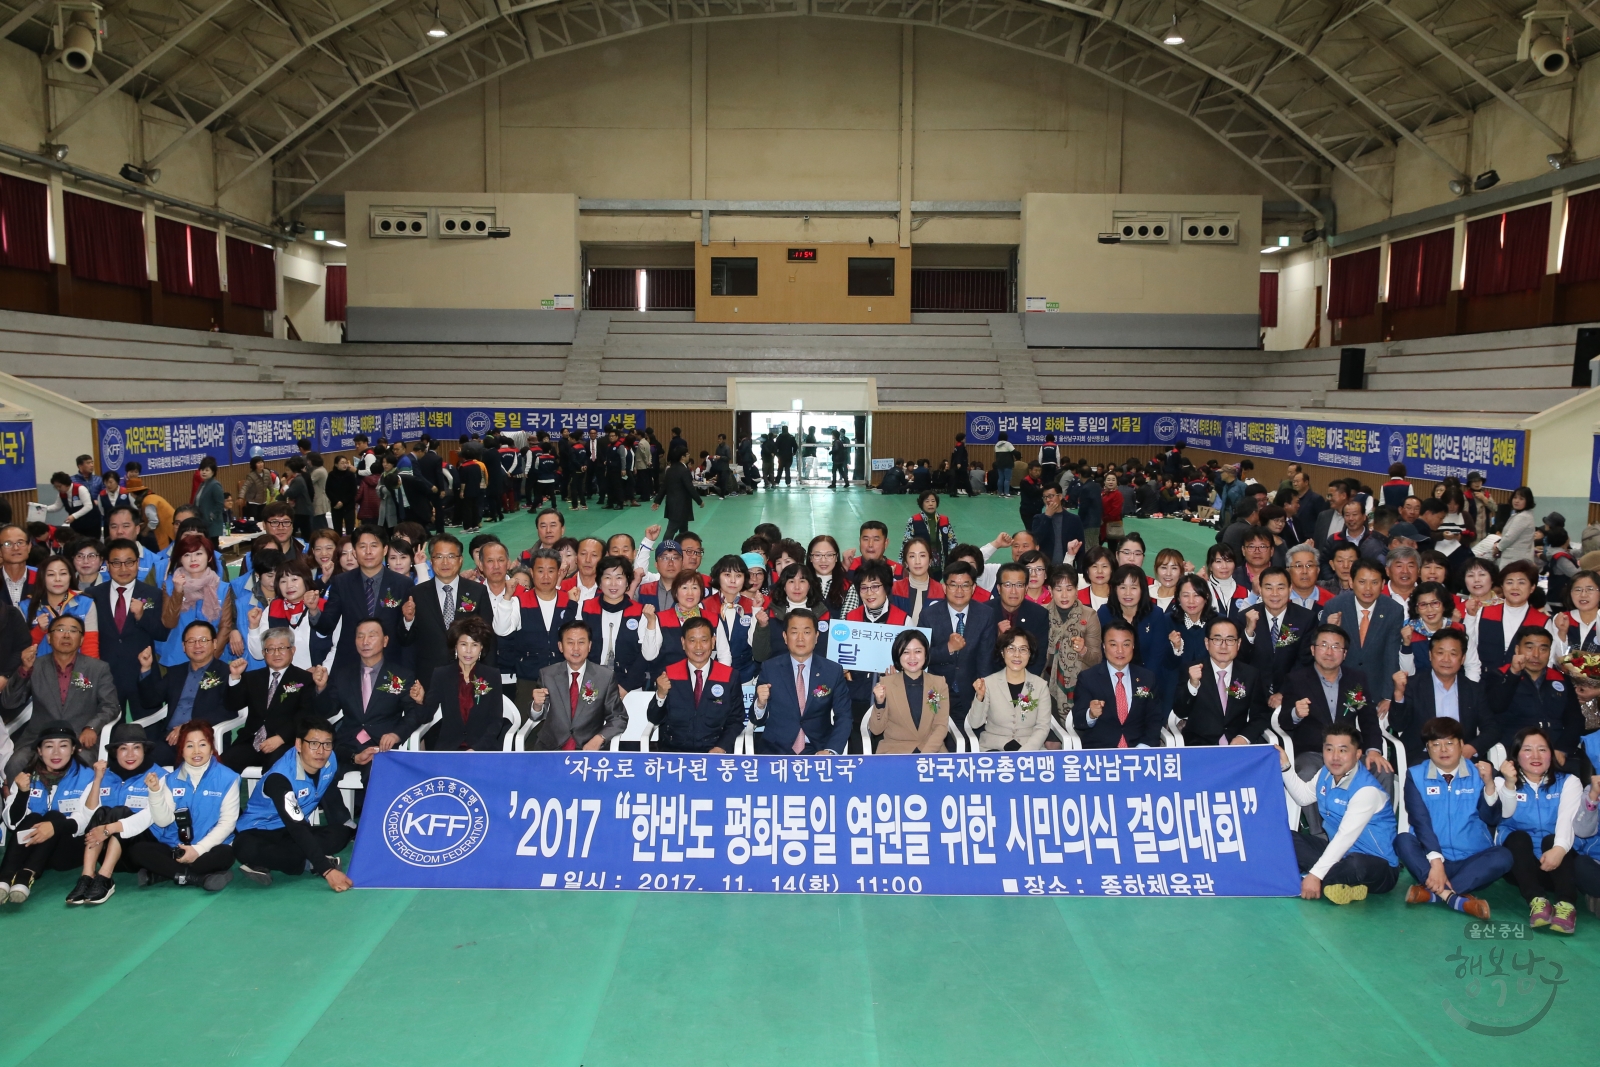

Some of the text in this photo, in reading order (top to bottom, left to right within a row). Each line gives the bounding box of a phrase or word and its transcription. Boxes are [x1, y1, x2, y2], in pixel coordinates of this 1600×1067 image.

[247, 420, 273, 444] 국민통합을
[273, 419, 292, 442] 주도하는
[306, 418, 316, 438] 조직
[428, 411, 452, 428] 선봉대
[493, 412, 637, 430] 통일 국가 건설의 선봉
[998, 416, 1142, 432] 남과 북의 화해는 통일의 지름길
[125, 425, 172, 454] 자유민주주의를
[172, 424, 196, 451] 수호하는
[1248, 422, 1264, 442] 대한민국
[1306, 426, 1326, 448] 회원역량
[1344, 429, 1367, 453] 국민운동
[1368, 430, 1380, 454] 선도
[106, 444, 120, 456] KFF
[1406, 432, 1516, 467] 젊은 인재 양성으로 연맹회원 정예화
[851, 629, 896, 642] 한국자유
[838, 643, 860, 666] 달
[644, 757, 708, 782] 하나된
[716, 758, 759, 783] 통일
[916, 753, 1182, 783] 한국자유총연맹 울산남구지회
[402, 780, 478, 806] 한국자유총연맹
[404, 812, 469, 836] KFF
[724, 794, 837, 866] 평화통일
[846, 793, 930, 866] 염원을
[940, 794, 997, 866] 위한
[1006, 794, 1122, 865] 시민의식
[388, 811, 484, 864] KOREA FREEDOM FEDERATION
[640, 874, 704, 891] 2017.
[722, 876, 753, 892] 11.
[772, 874, 840, 892] 14(화)
[856, 876, 922, 894] 11:00
[1101, 873, 1216, 896] 종하체육관
